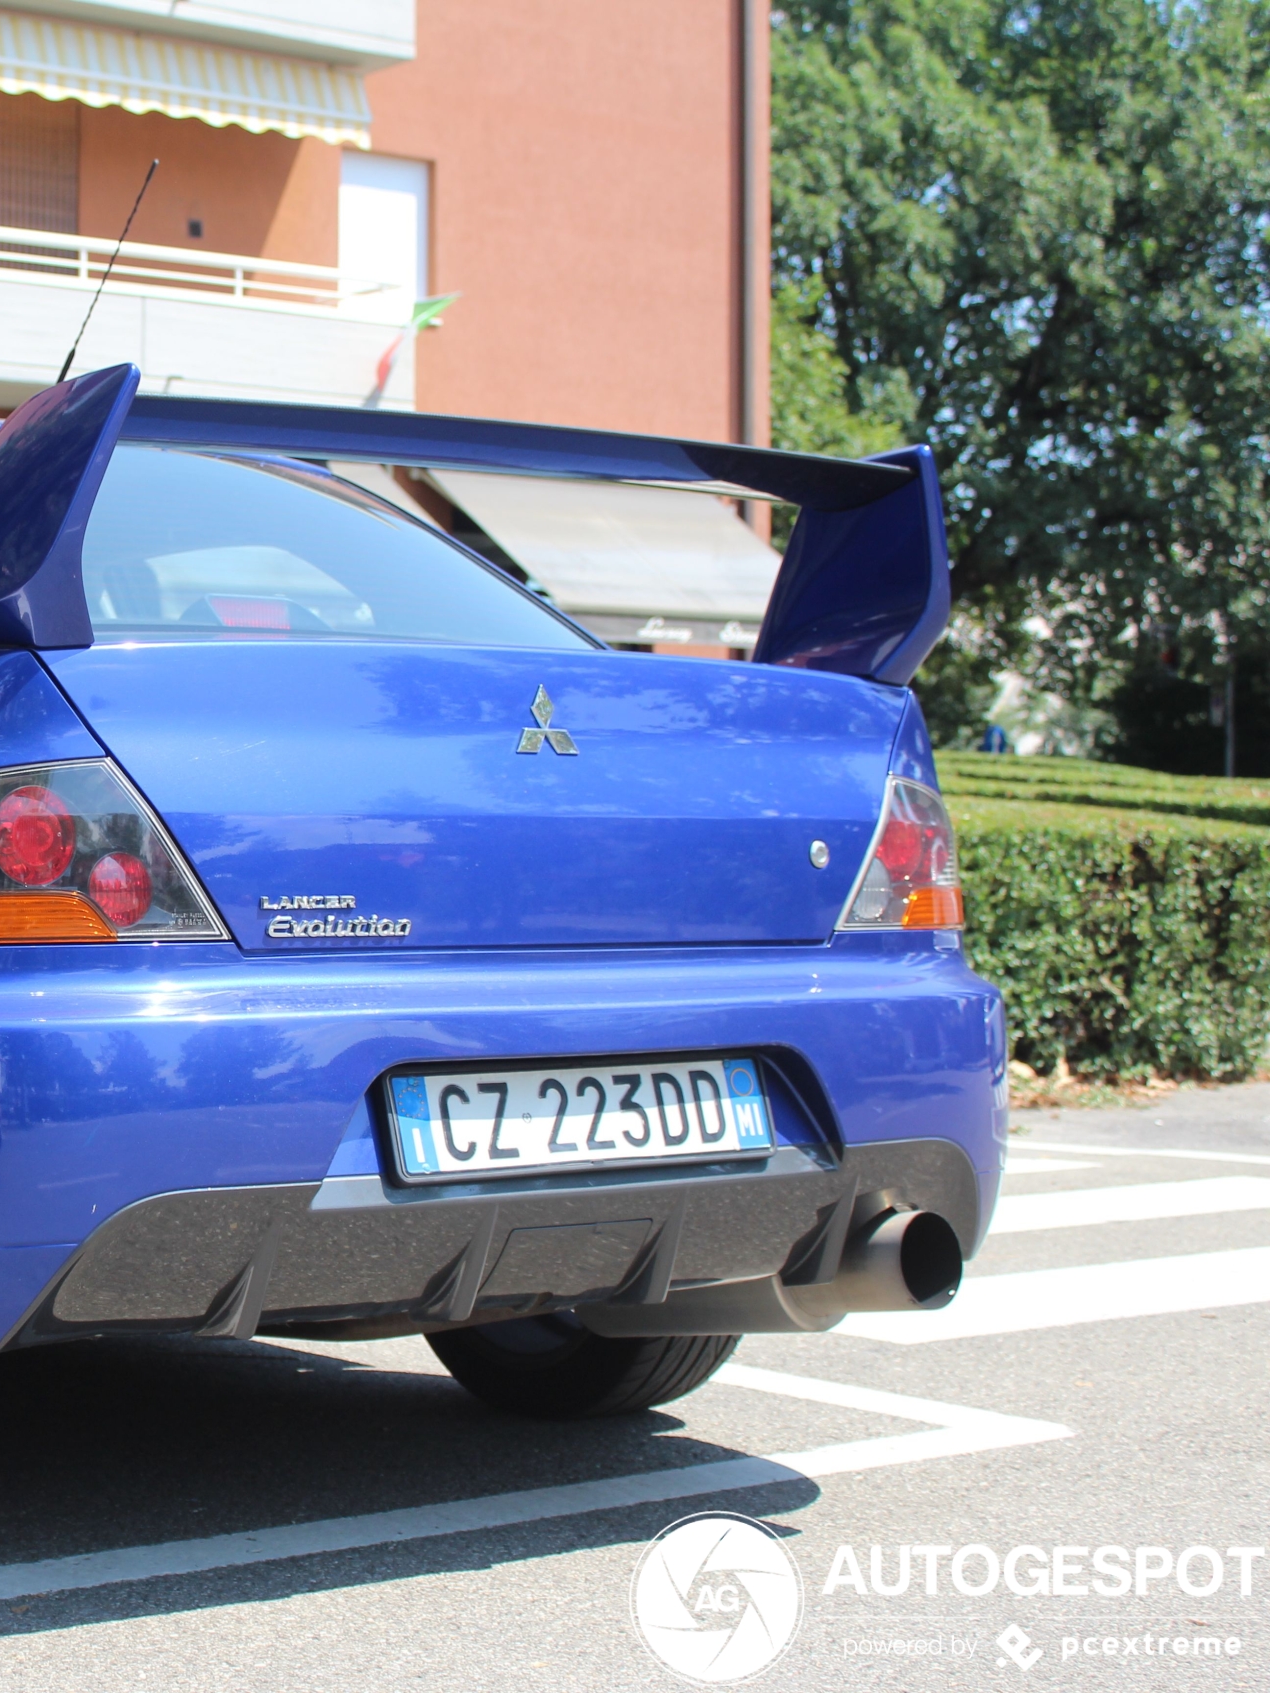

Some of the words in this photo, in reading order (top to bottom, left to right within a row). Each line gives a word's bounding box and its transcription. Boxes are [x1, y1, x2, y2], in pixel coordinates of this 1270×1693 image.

[260, 895, 357, 910] LANCER
[267, 914, 412, 938] Evolution
[439, 1082, 520, 1161] CZ
[538, 1070, 726, 1153] 223DD
[735, 1103, 764, 1137] MI
